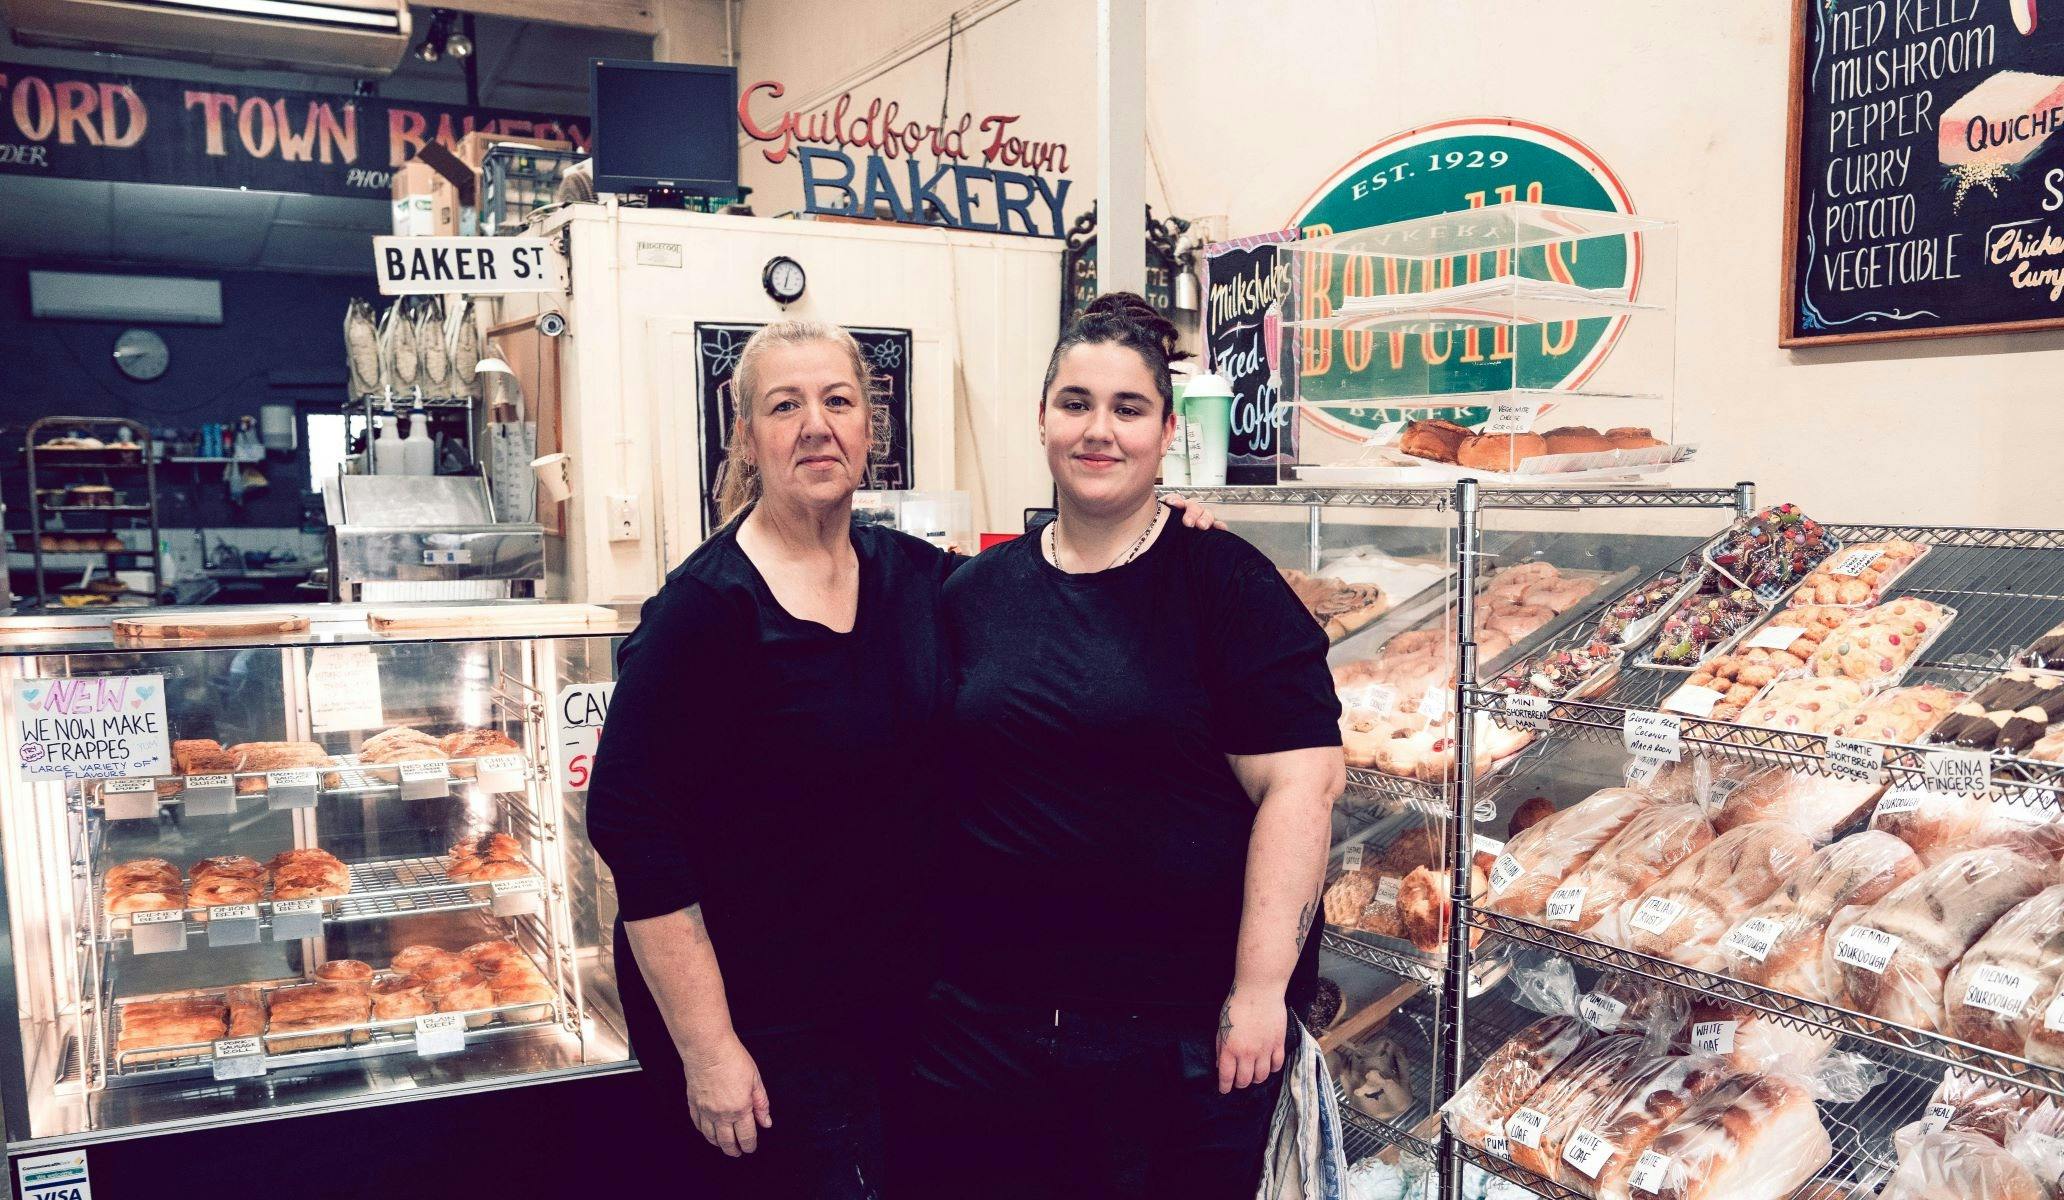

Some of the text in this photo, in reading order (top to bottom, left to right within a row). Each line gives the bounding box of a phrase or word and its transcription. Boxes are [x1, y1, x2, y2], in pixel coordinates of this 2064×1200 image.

[1832, 0, 1979, 54] NED KELLY
[1831, 24, 1995, 104] MUSHROOM
[0, 72, 147, 148] ORD
[184, 90, 358, 165] TOWN
[738, 81, 1069, 174] Guildford Town
[1829, 89, 1933, 153] PEPPER
[1352, 150, 1510, 201] EST. 1929
[1826, 146, 1911, 198] CURRY
[798, 146, 1072, 239] BAKERY
[1825, 194, 1915, 247] POTATO
[385, 246, 497, 281] BAKER
[1824, 233, 1963, 292] VEGETABLE
[1210, 254, 1292, 336] Milkshakes
[1231, 385, 1290, 451] Coffee
[1491, 423, 1524, 431] SCROLS
[43, 676, 129, 715] NEW
[1512, 698, 1534, 707] MINI
[1506, 708, 1548, 720] SHORTBREAD
[1515, 719, 1537, 728] MAN
[1628, 712, 1679, 729] GLUTEN FREE
[21, 712, 159, 742] WE NOW MAKE
[1634, 725, 1668, 741] COCONUT
[22, 745, 37, 755] TRY
[25, 751, 43, 761] NOW
[47, 738, 130, 762] FRAPPES
[1630, 739, 1673, 755] MACAROON
[1835, 739, 1873, 757] SMARTIE
[31, 759, 152, 774] LARGE VARIETY OF
[1825, 750, 1878, 771] SHORTBREAD
[1930, 756, 1984, 776] VIENNA
[65, 770, 127, 779] FLAVOURS
[1831, 762, 1869, 780] COOKIES
[1927, 776, 1985, 791] FINGERS
[1553, 888, 1581, 900] ITALIAN
[213, 904, 251, 913] ONION
[1547, 903, 1575, 917] CRUSTY
[1850, 926, 1890, 946] VIENNA
[1838, 941, 1887, 970] SOURDOUGH
[1966, 985, 2023, 1013] SOURDOUGH
[1696, 1023, 1724, 1036] WHITE
[1511, 1124, 1529, 1142] LOAF
[1576, 1132, 1602, 1151] WHITE
[1569, 1144, 1592, 1164] LOAF
[33, 1188, 83, 1200] VISA
